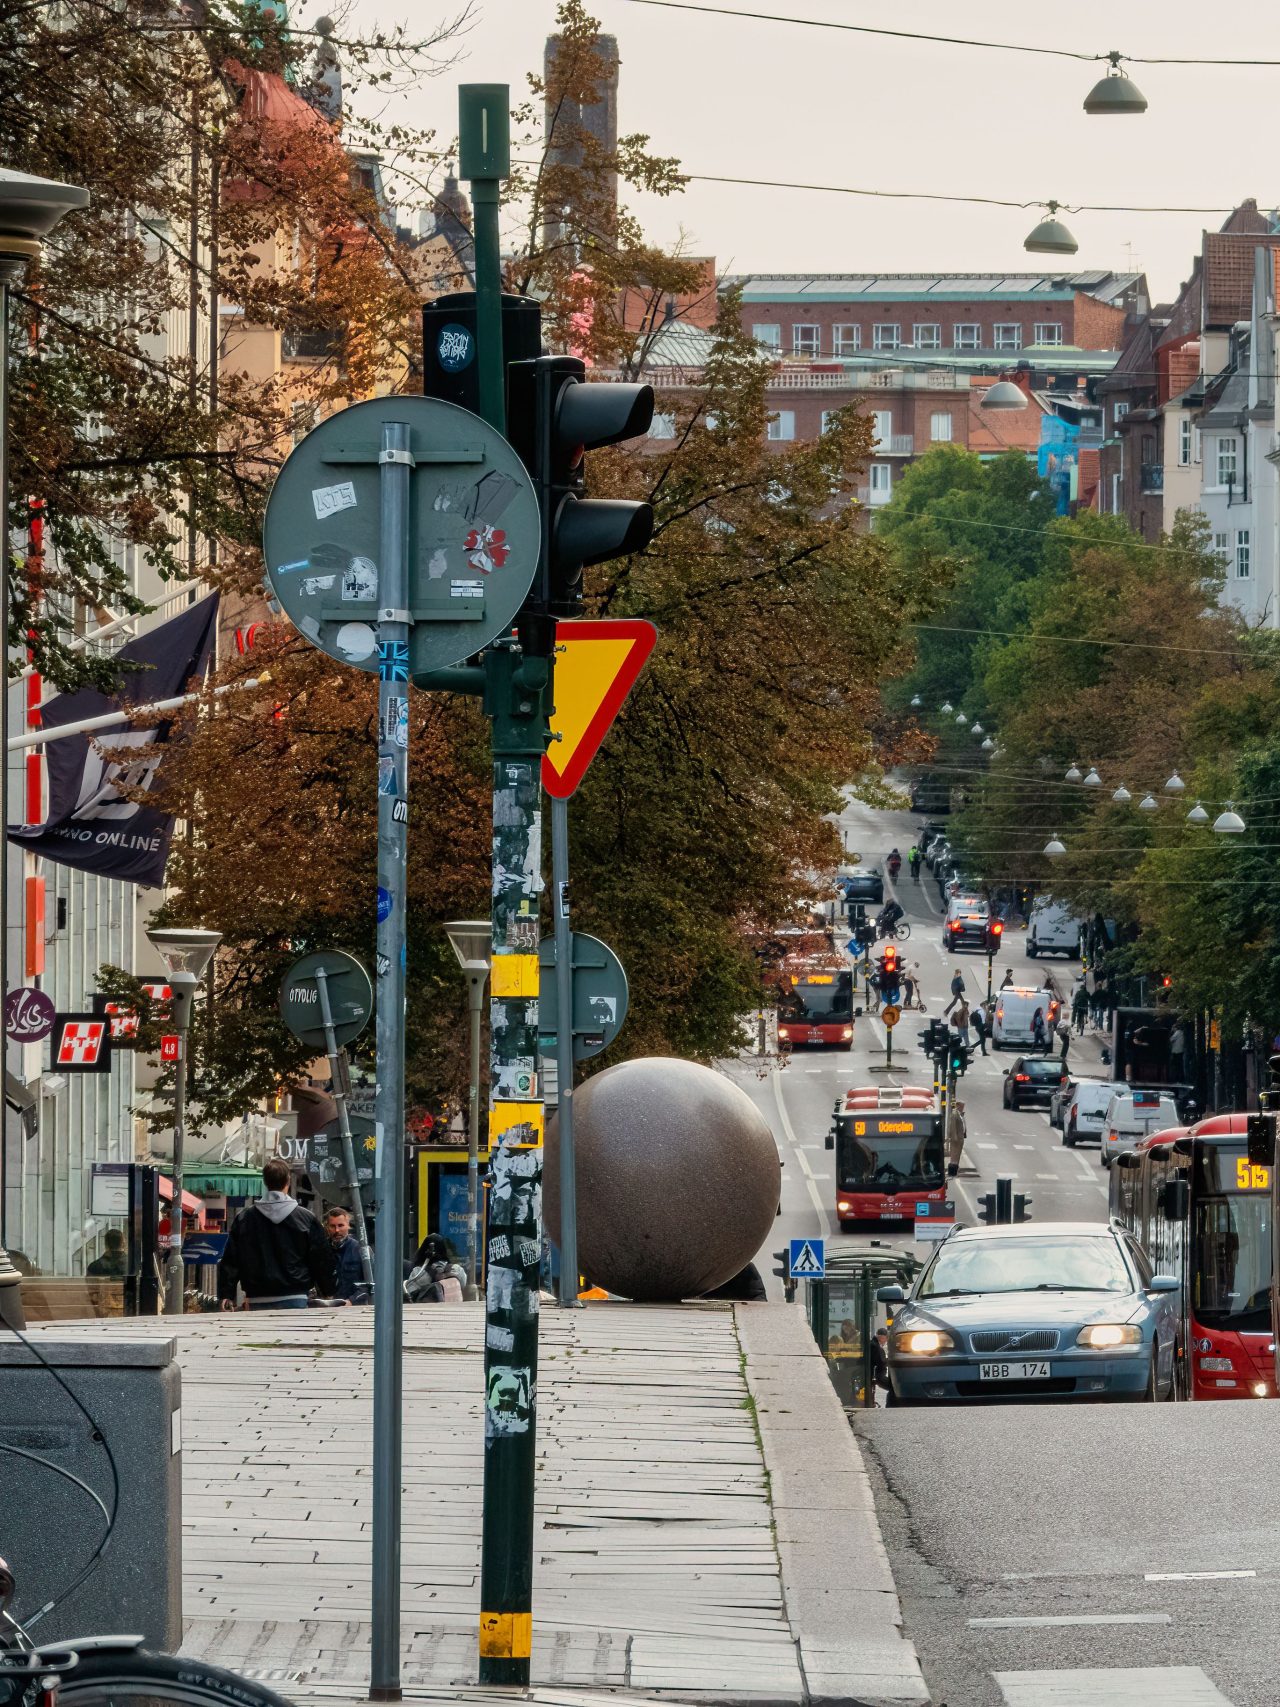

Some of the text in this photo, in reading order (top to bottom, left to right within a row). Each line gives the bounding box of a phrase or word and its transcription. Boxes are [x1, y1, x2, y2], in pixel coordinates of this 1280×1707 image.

[95, 832, 161, 852] ONLINE
[982, 1363, 1047, 1378] WBB 174
